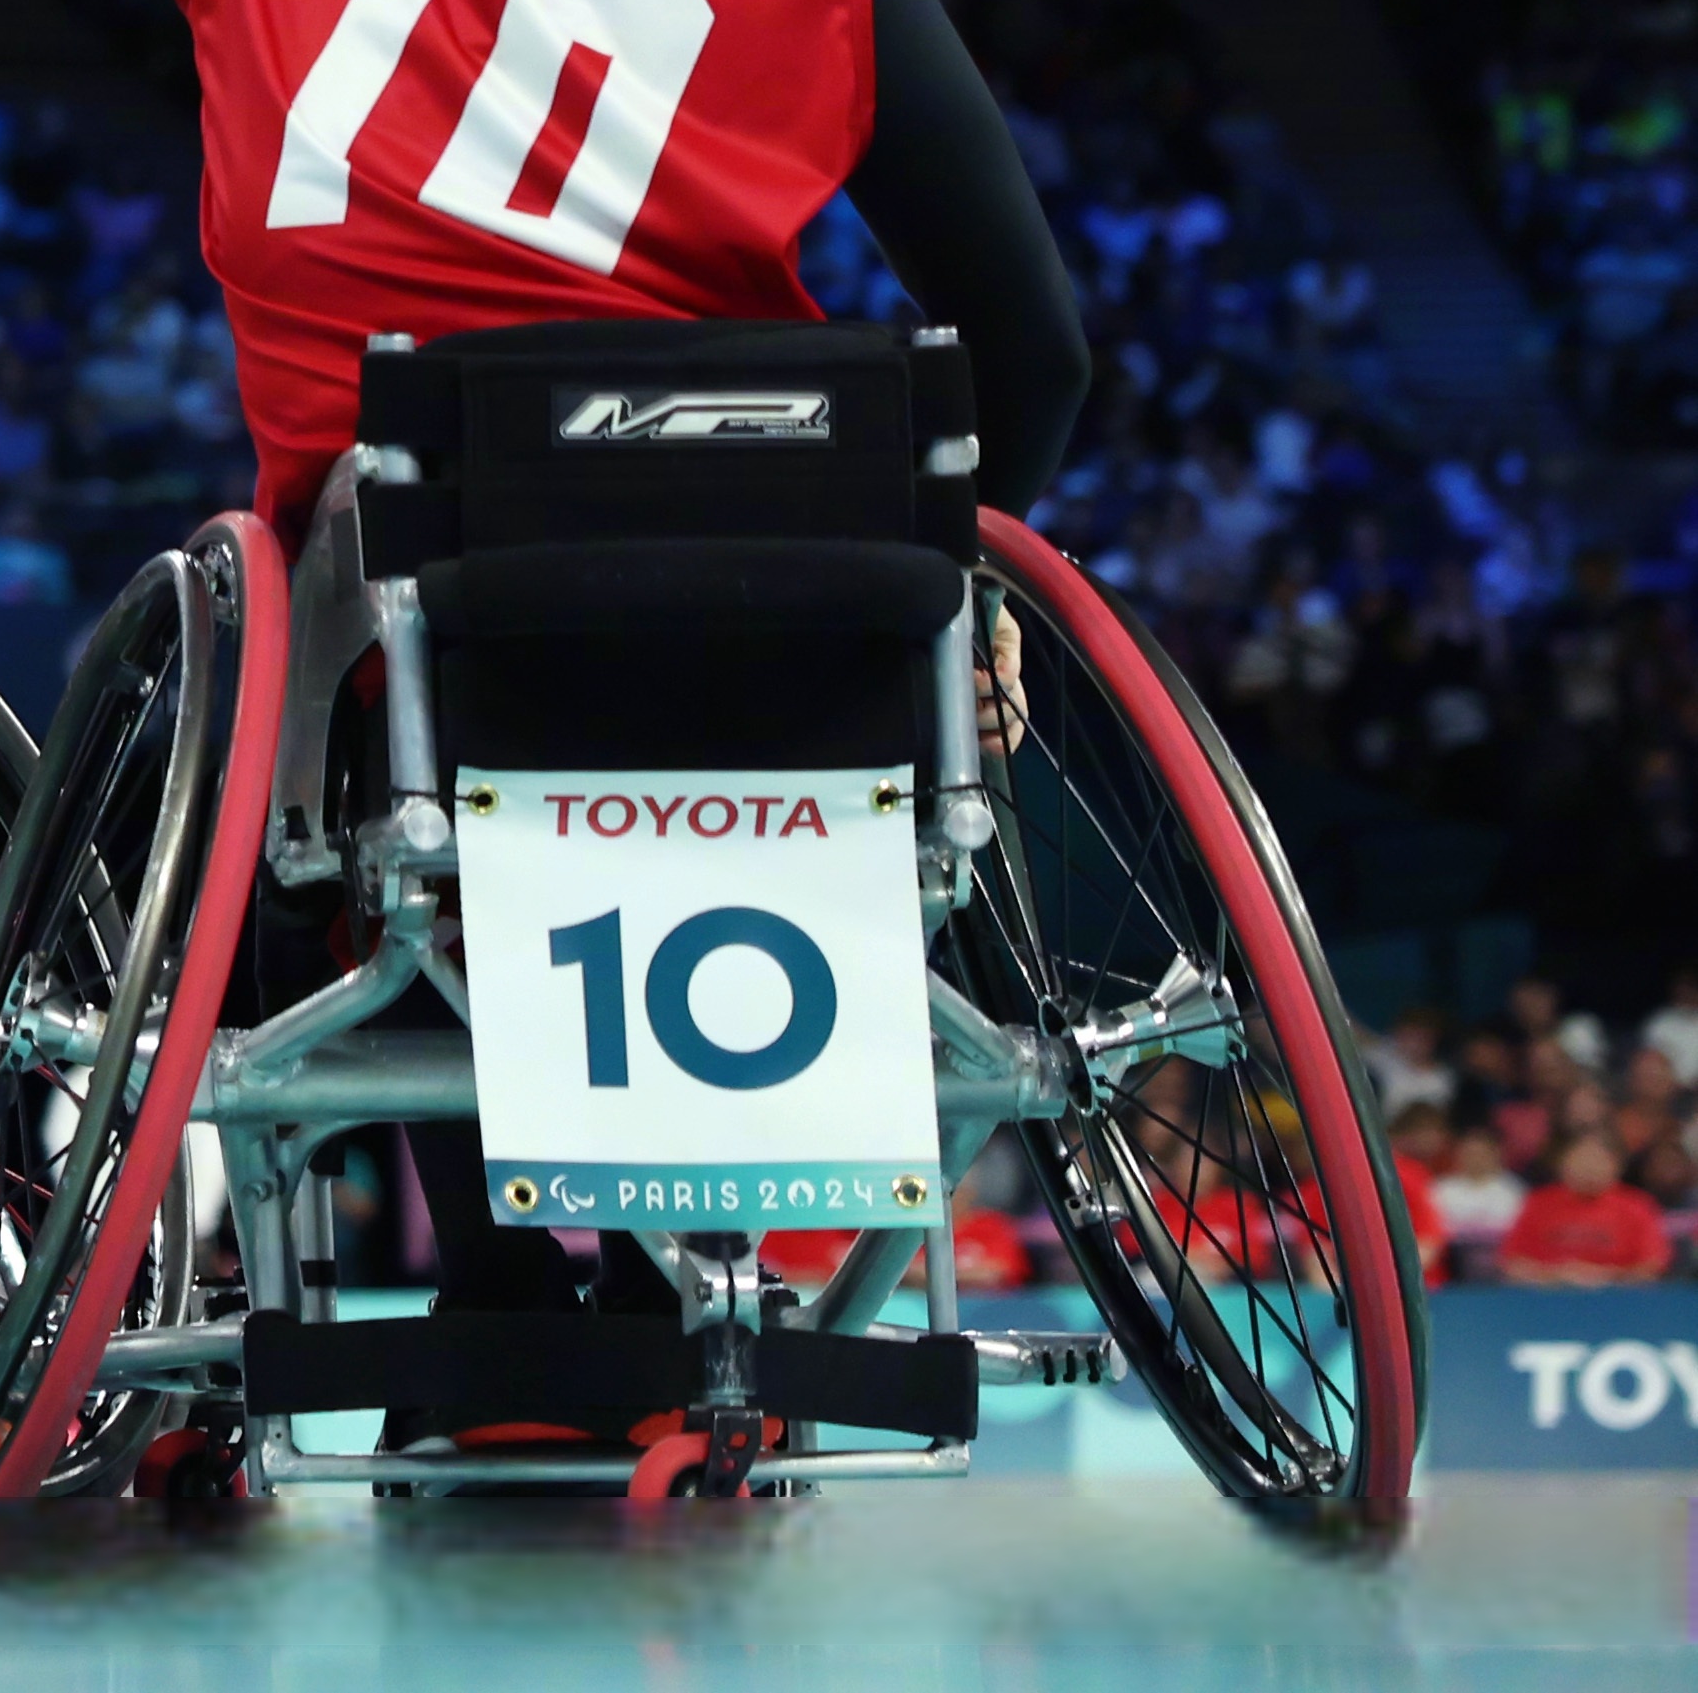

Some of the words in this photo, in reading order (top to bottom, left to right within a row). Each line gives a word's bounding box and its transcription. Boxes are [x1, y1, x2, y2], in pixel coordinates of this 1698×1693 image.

[544, 794, 829, 839] TOYOTA
[548, 905, 837, 1090] 10
[618, 1179, 741, 1212] PARIS
[759, 1178, 873, 1211] 2024
